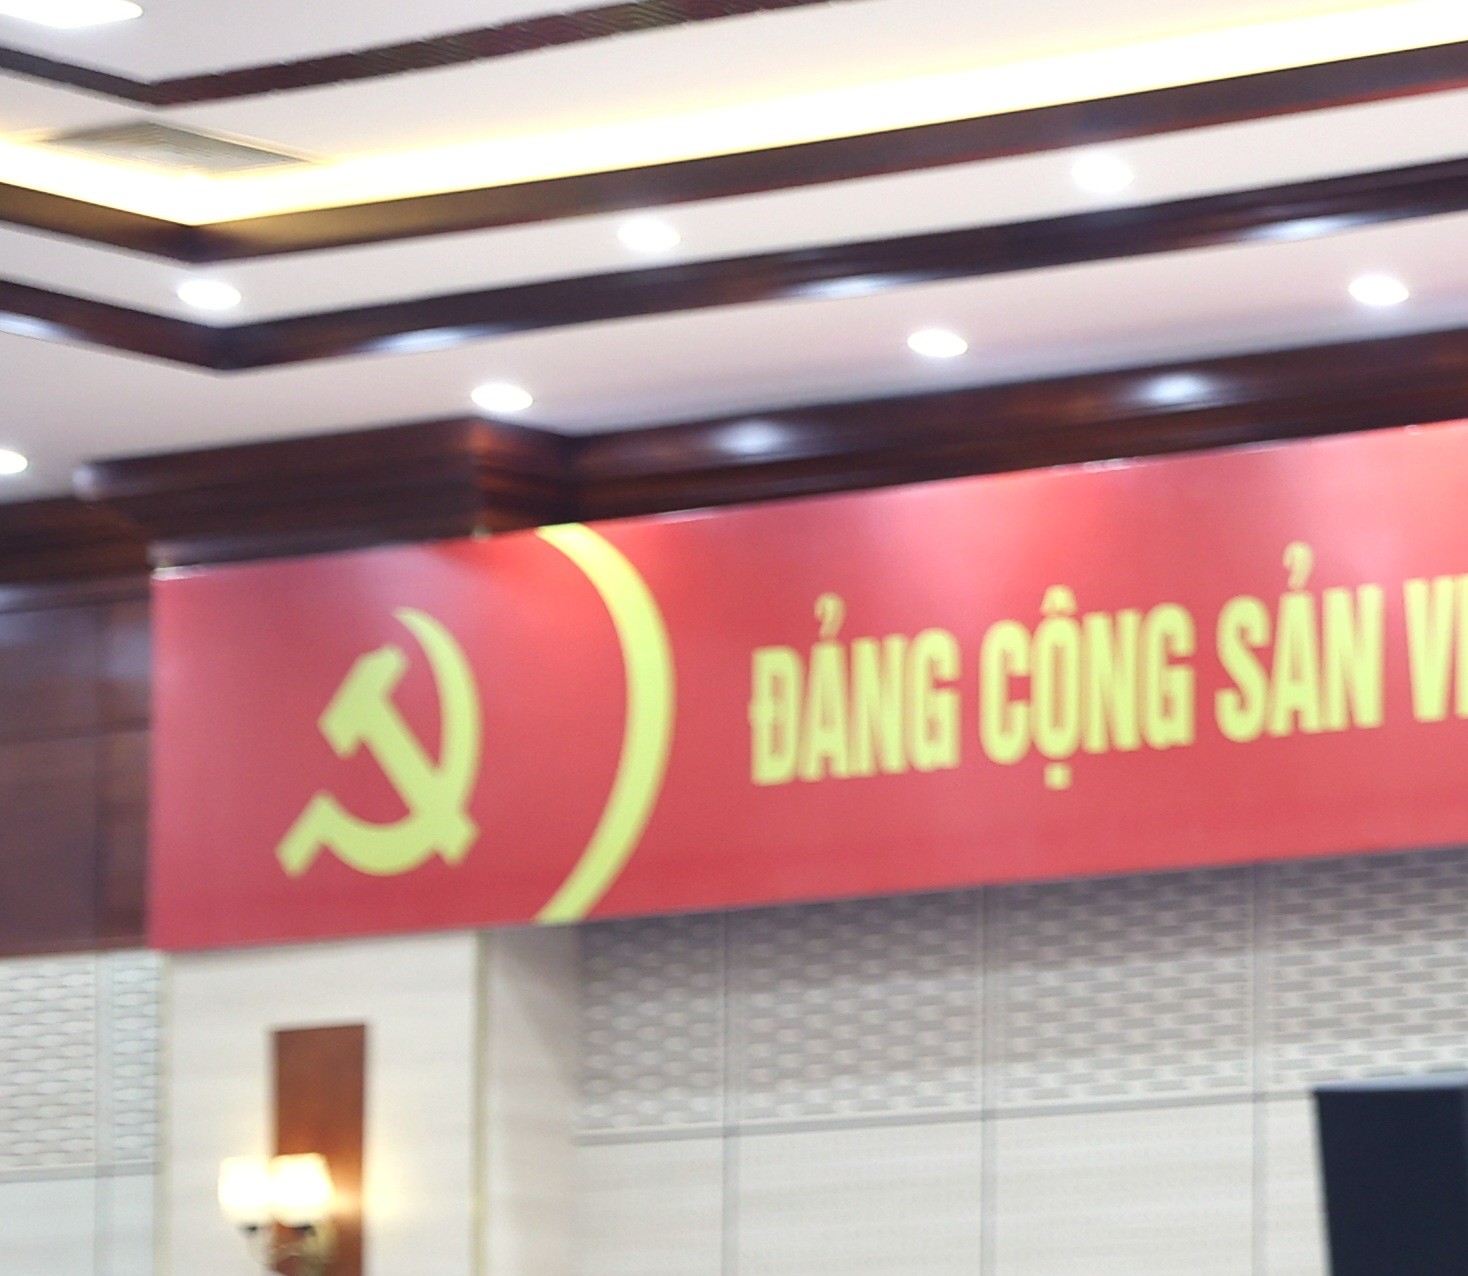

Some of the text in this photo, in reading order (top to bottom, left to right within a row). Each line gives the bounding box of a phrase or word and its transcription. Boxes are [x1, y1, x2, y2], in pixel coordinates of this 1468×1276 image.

[750, 592, 961, 784] ĐẢNG
[979, 584, 1195, 789] CỘNG
[1215, 540, 1384, 742] SẢN
